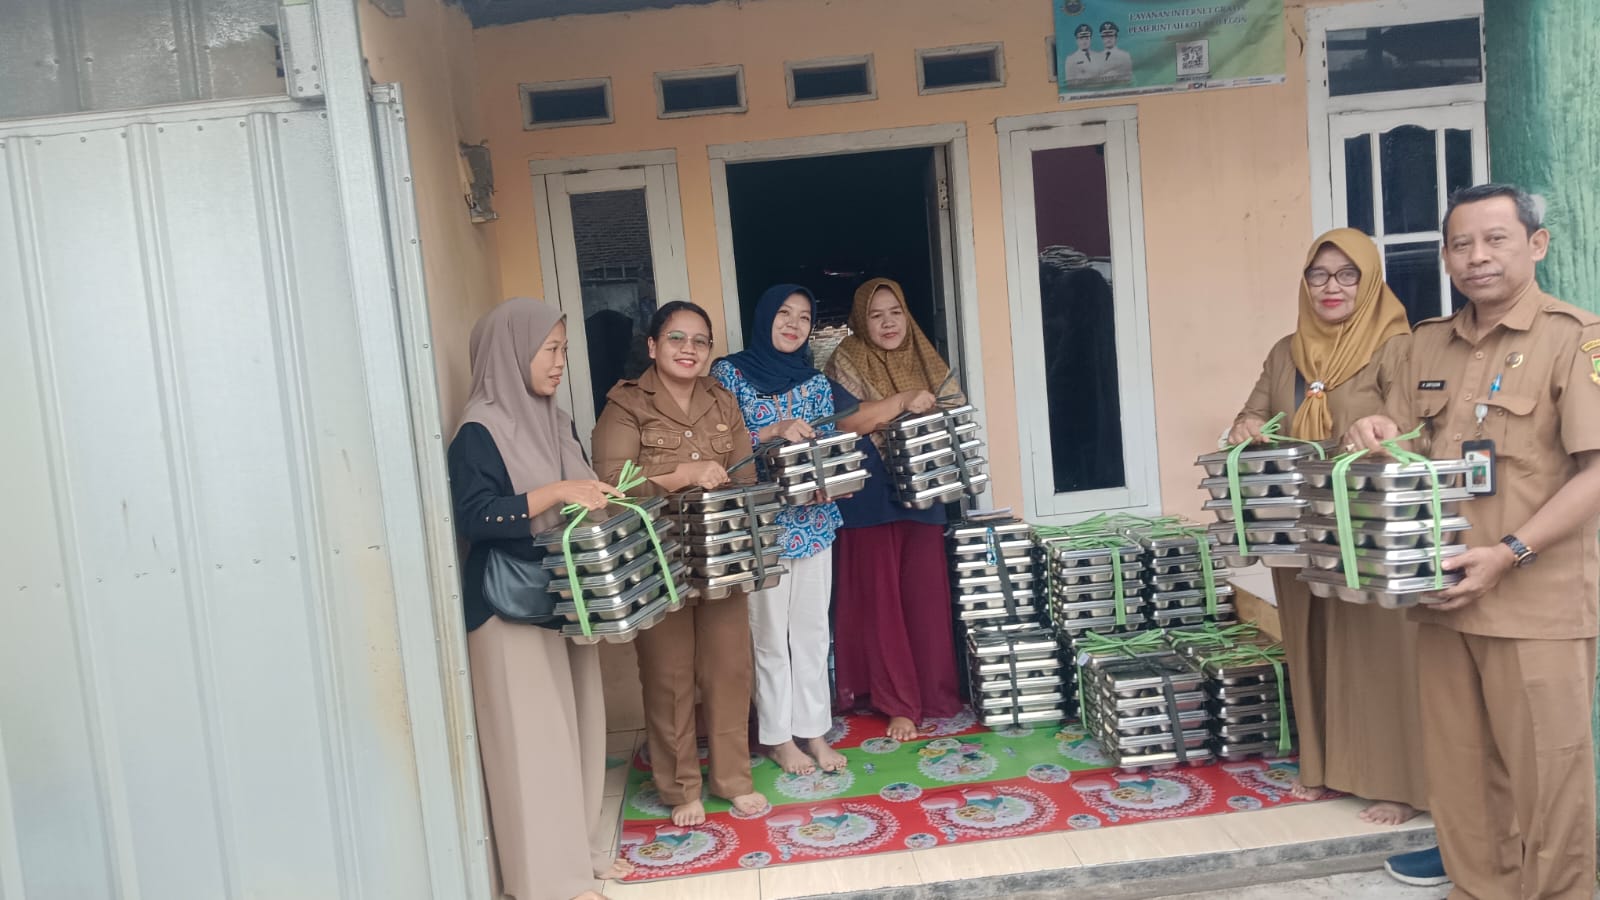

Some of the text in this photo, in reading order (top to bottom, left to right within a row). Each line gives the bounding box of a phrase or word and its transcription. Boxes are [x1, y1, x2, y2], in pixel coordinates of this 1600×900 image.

[1129, 11, 1170, 20] LAYANAN
[1171, 8, 1212, 17] INTERNET
[1129, 22, 1184, 33] PEMERINTAH
